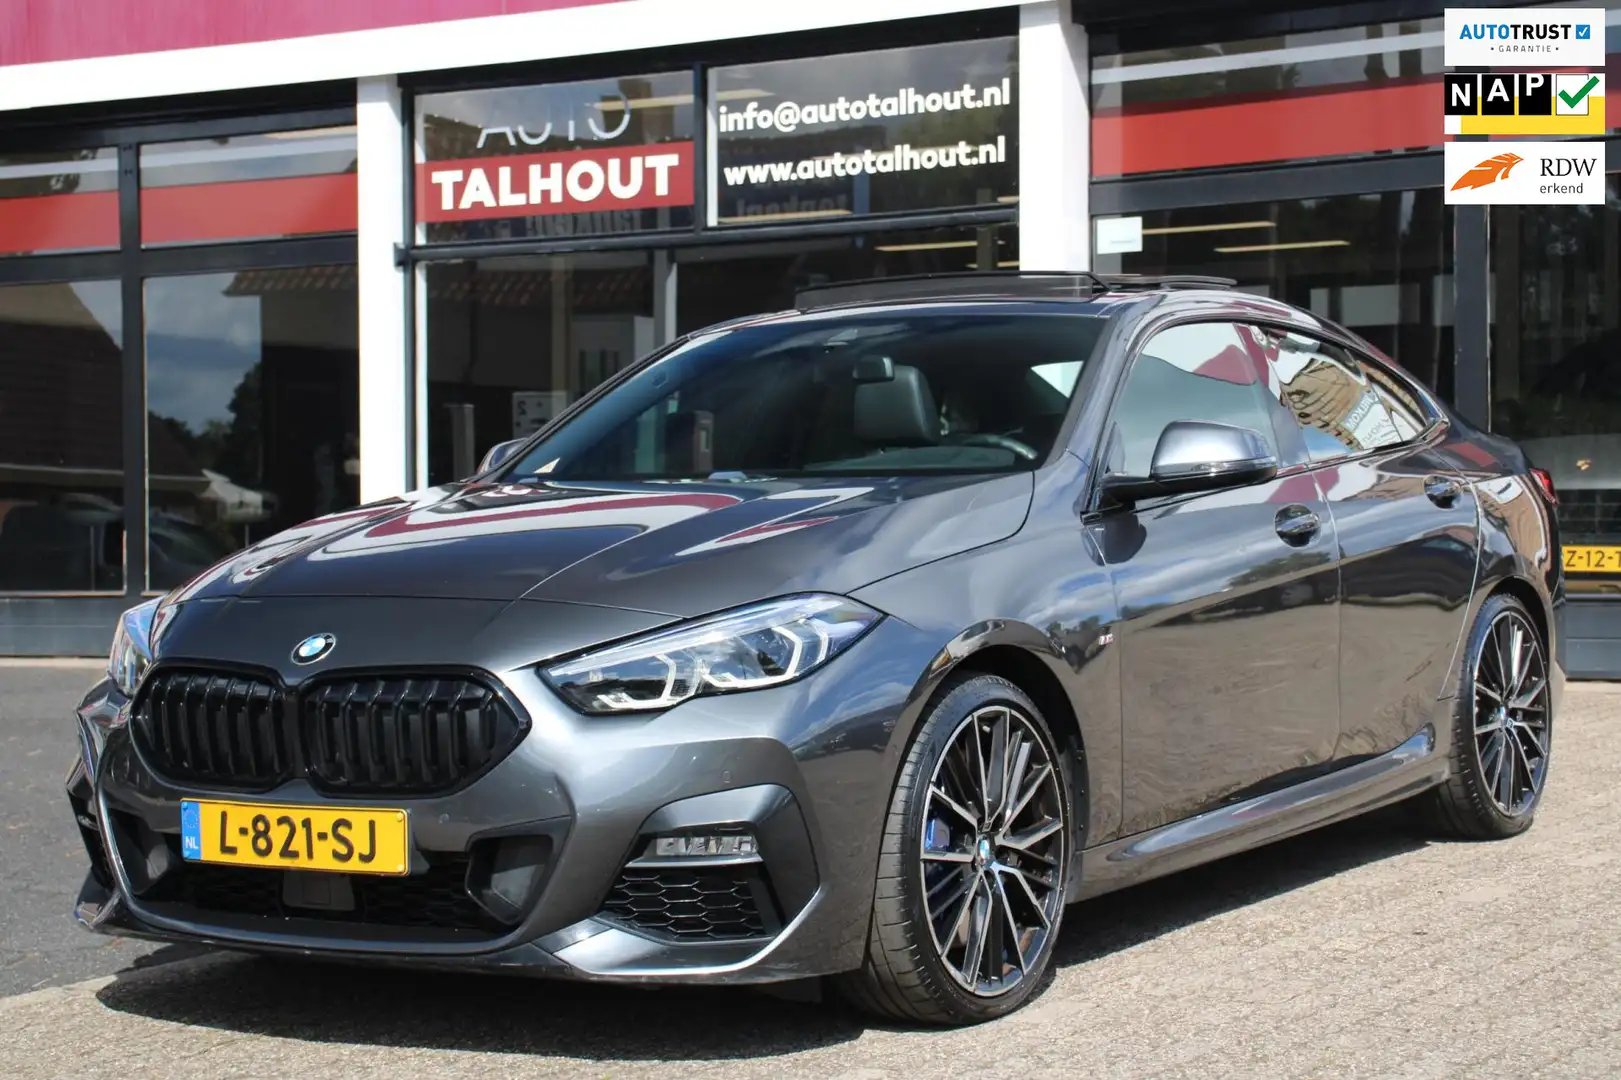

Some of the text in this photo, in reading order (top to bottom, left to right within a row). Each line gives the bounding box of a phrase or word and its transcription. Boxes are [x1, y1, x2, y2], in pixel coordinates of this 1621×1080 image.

[719, 77, 1010, 132] info@autotalhout.nl
[431, 153, 679, 211] TALHOUT
[723, 135, 1006, 186] www.autotalhout.nl
[185, 835, 199, 849] NL
[219, 810, 377, 863] L-821-SJ
